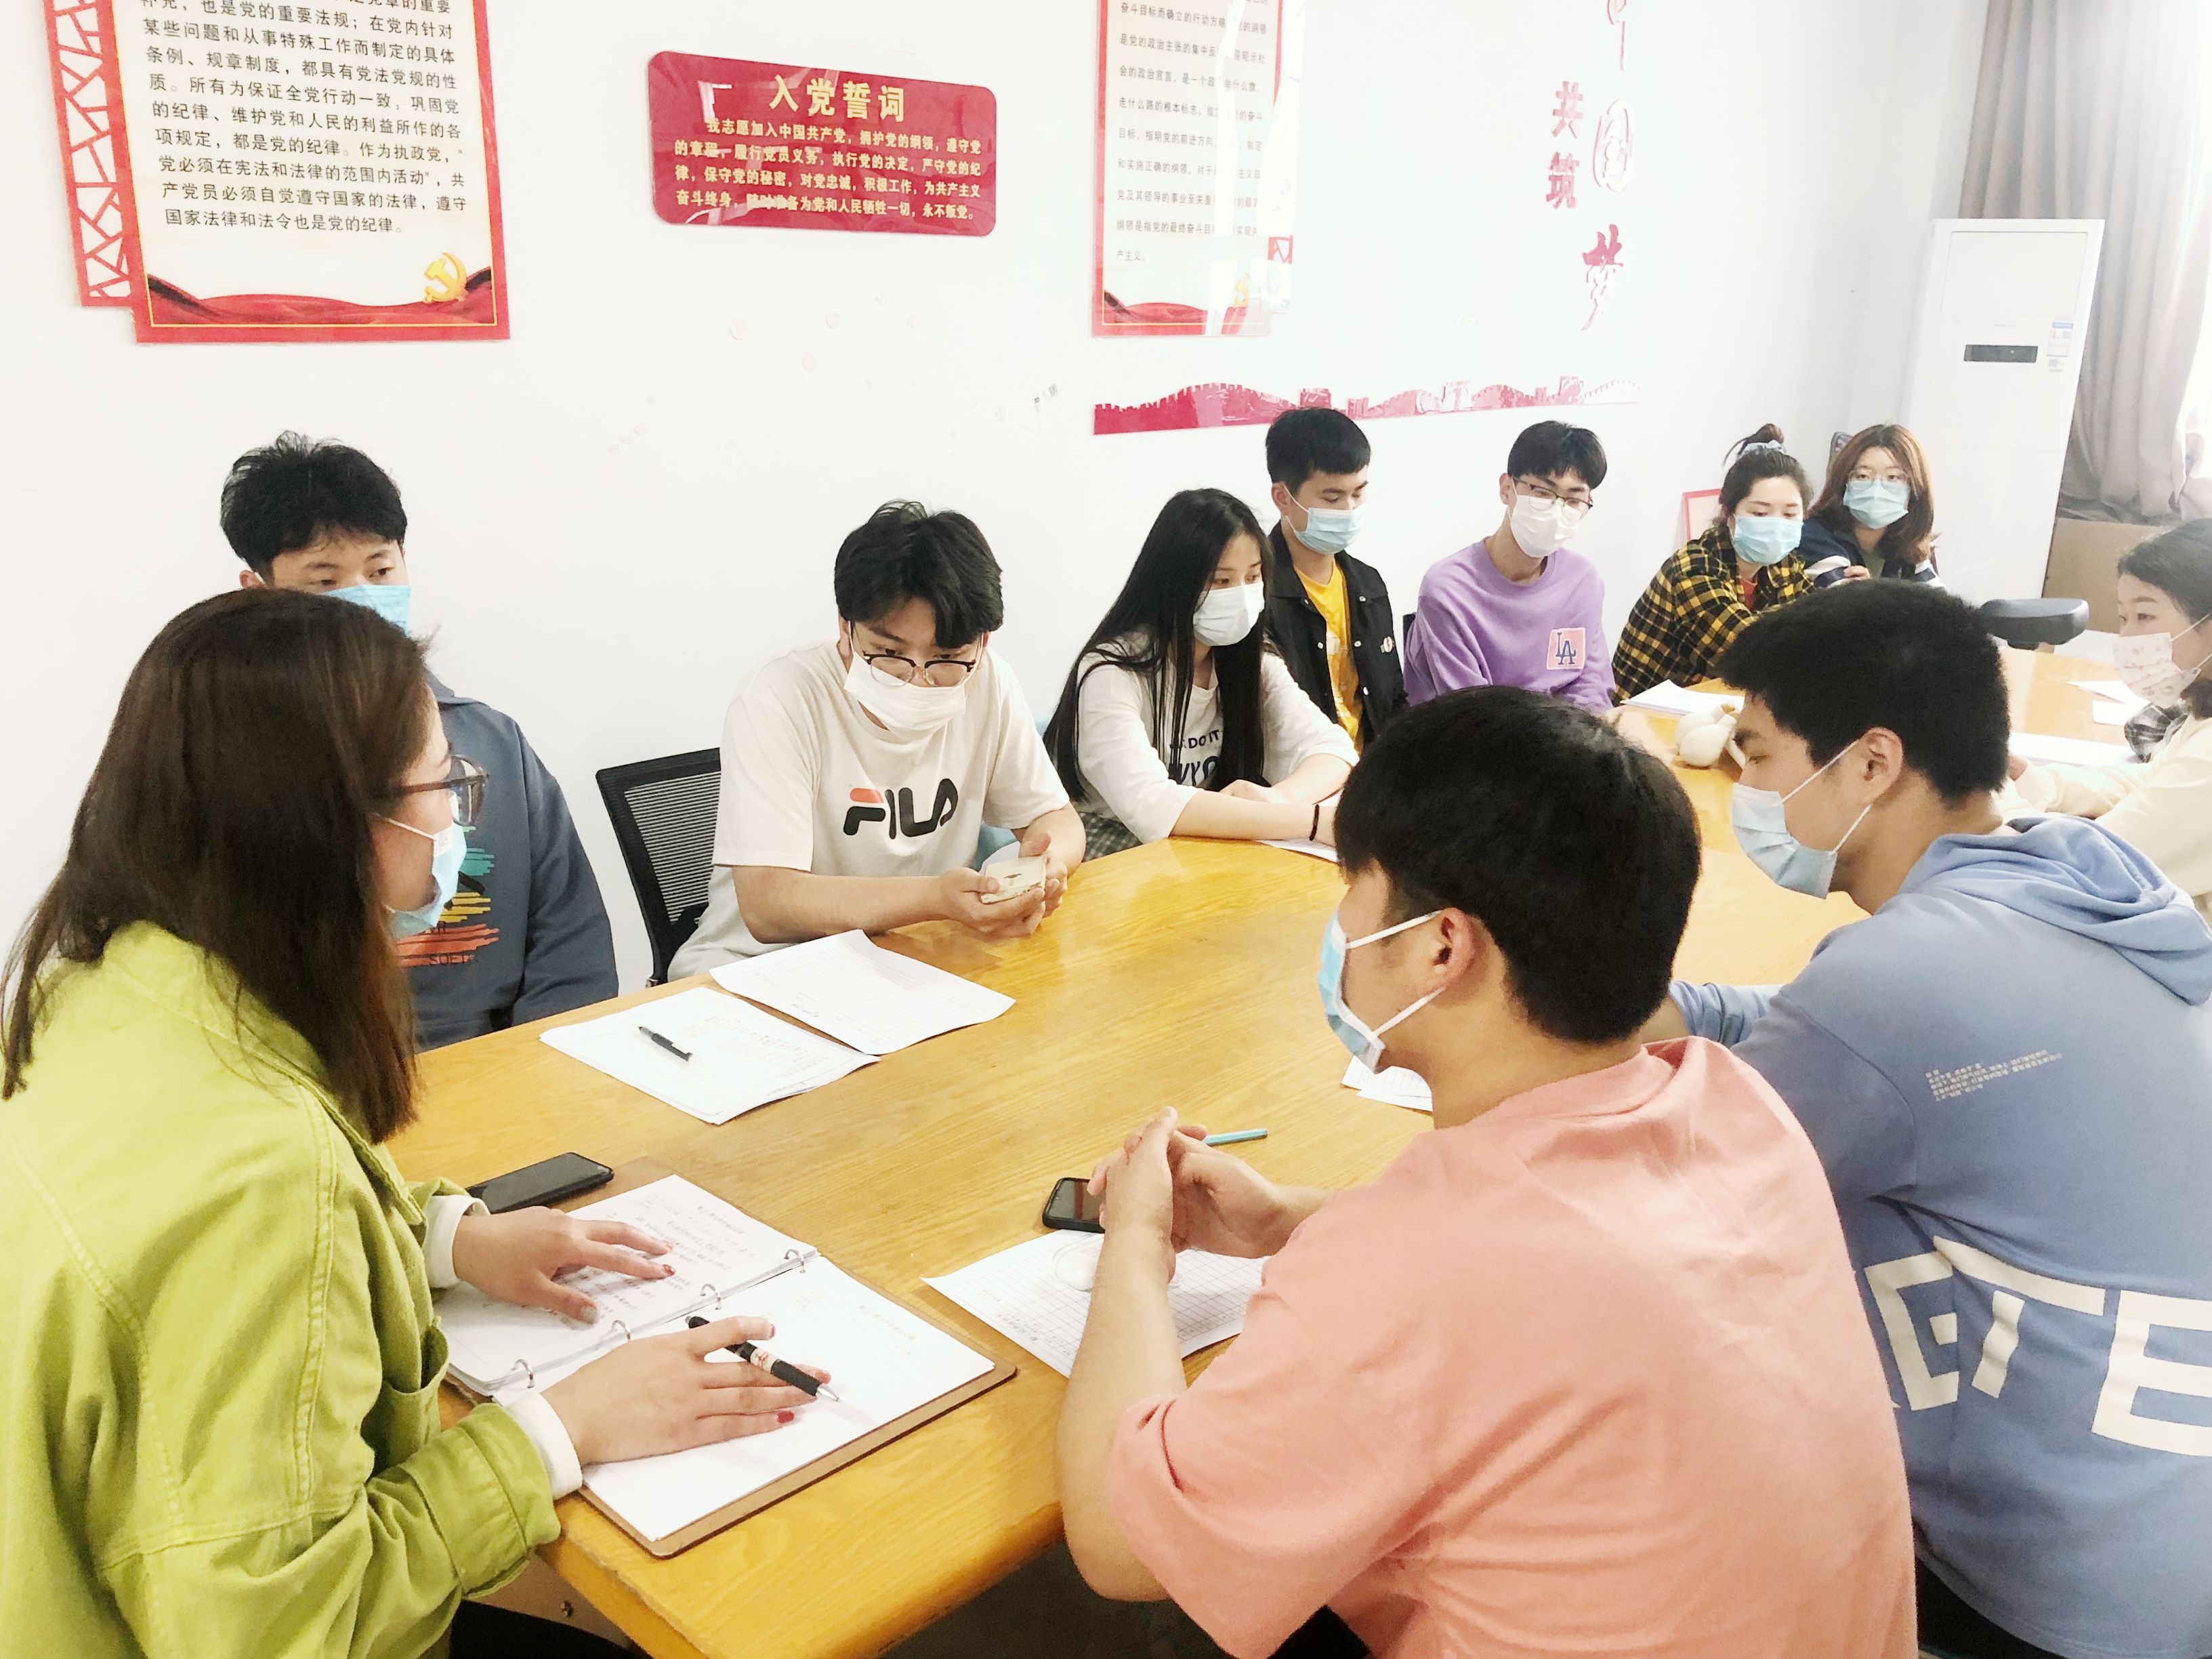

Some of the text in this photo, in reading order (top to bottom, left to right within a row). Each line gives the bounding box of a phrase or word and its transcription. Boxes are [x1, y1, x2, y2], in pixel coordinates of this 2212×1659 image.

[142, 18, 455, 64] 某些问题和从事特殊工作而制定的具体
[768, 74, 904, 123] 入党誓词
[1546, 80, 1583, 210] 共筑
[165, 209, 402, 234] 国家法律和法令也是党的纪律。
[1555, 631, 1577, 665] LA
[1188, 735, 1207, 749] DO
[843, 778, 959, 840] FILA
